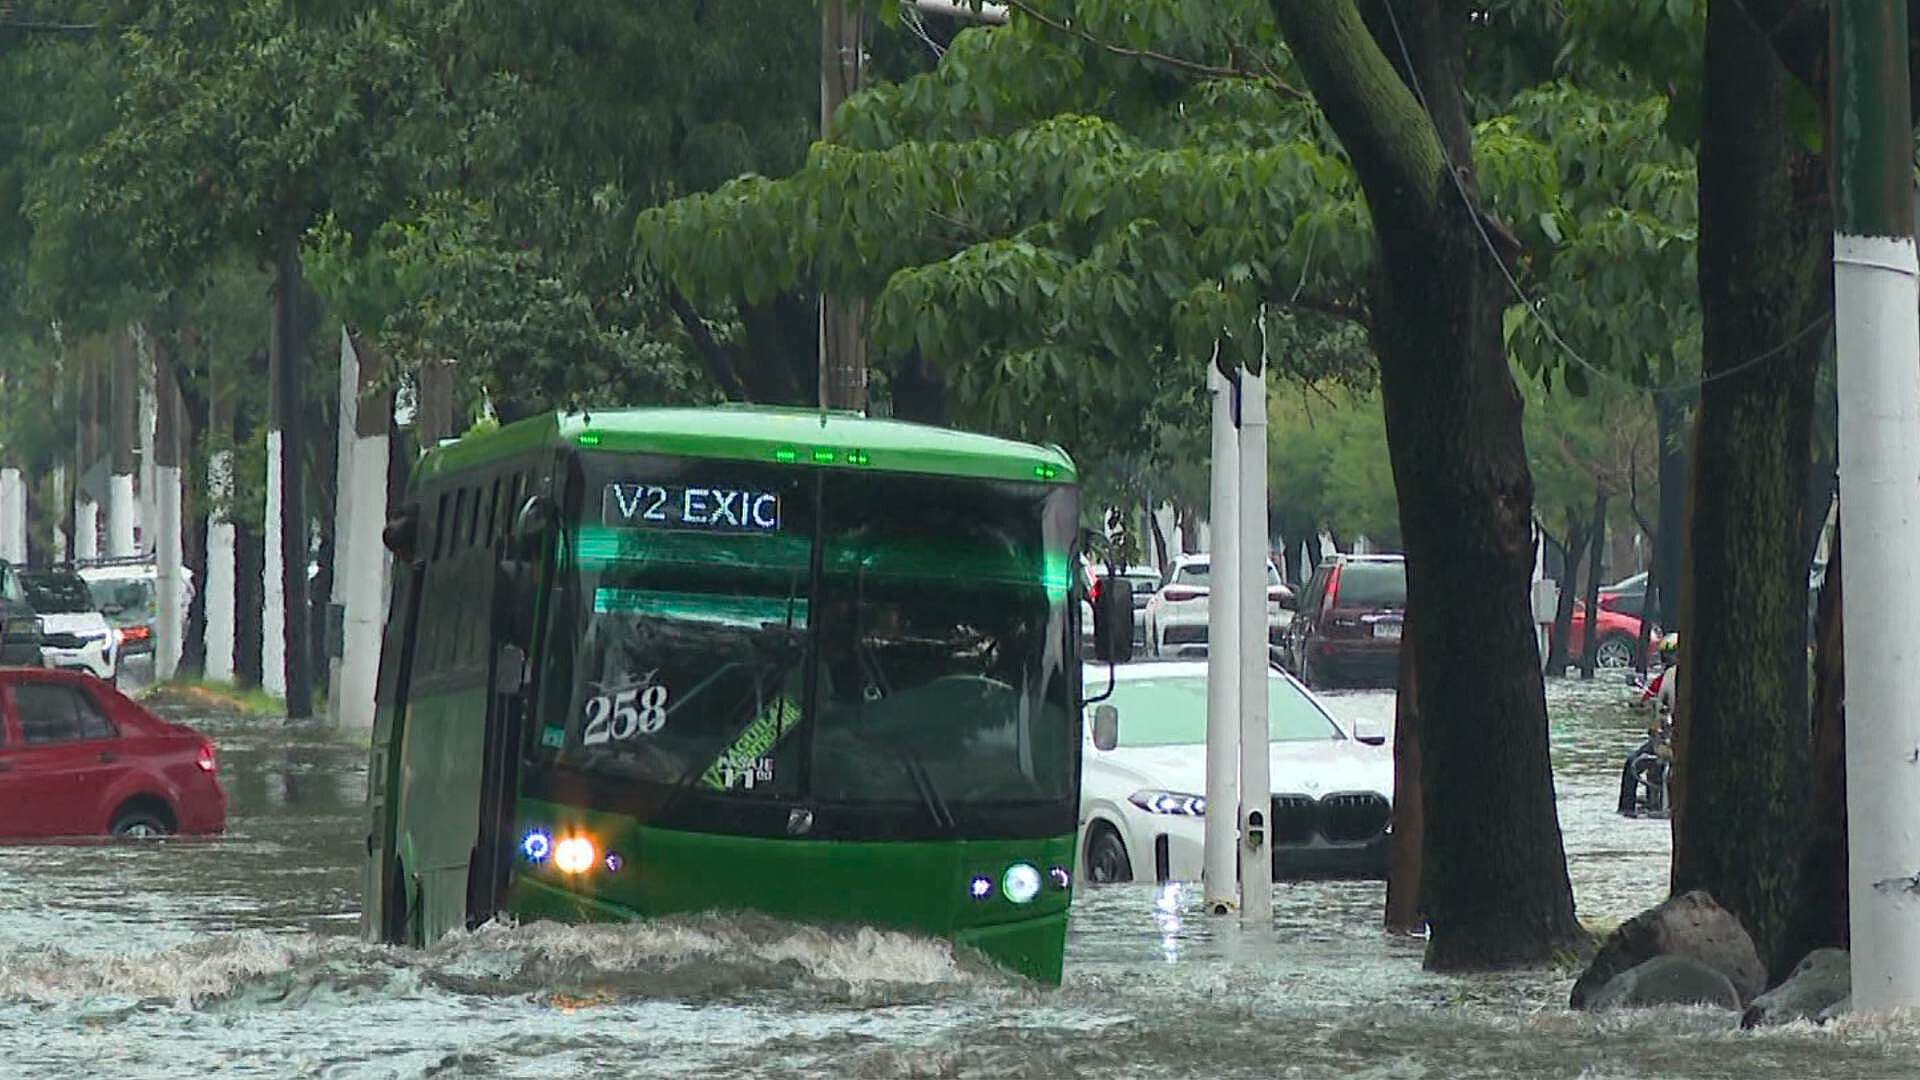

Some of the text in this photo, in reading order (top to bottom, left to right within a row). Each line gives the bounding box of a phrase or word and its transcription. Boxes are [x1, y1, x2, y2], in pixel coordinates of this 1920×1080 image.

[613, 484, 777, 528] V2 EXIC
[583, 685, 668, 746] 258
